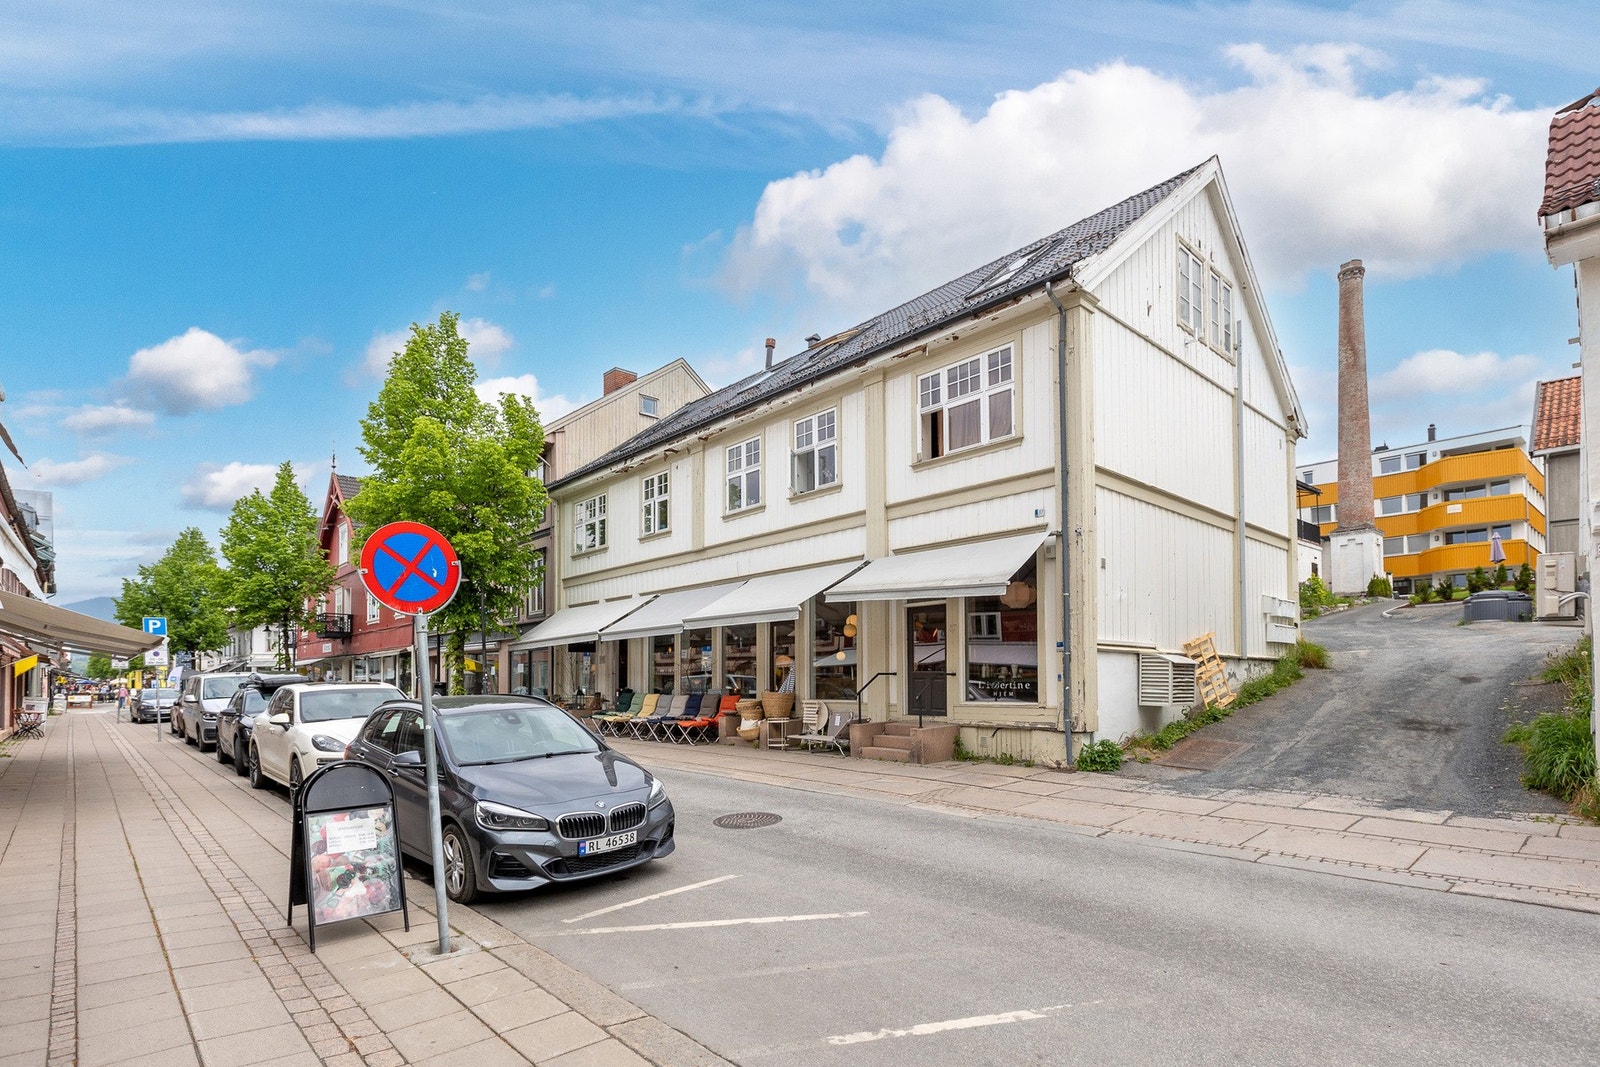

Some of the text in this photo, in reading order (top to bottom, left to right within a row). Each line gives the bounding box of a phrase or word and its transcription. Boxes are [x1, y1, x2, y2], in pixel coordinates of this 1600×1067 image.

[148, 620, 161, 633] P
[588, 832, 635, 852] RL 46538
